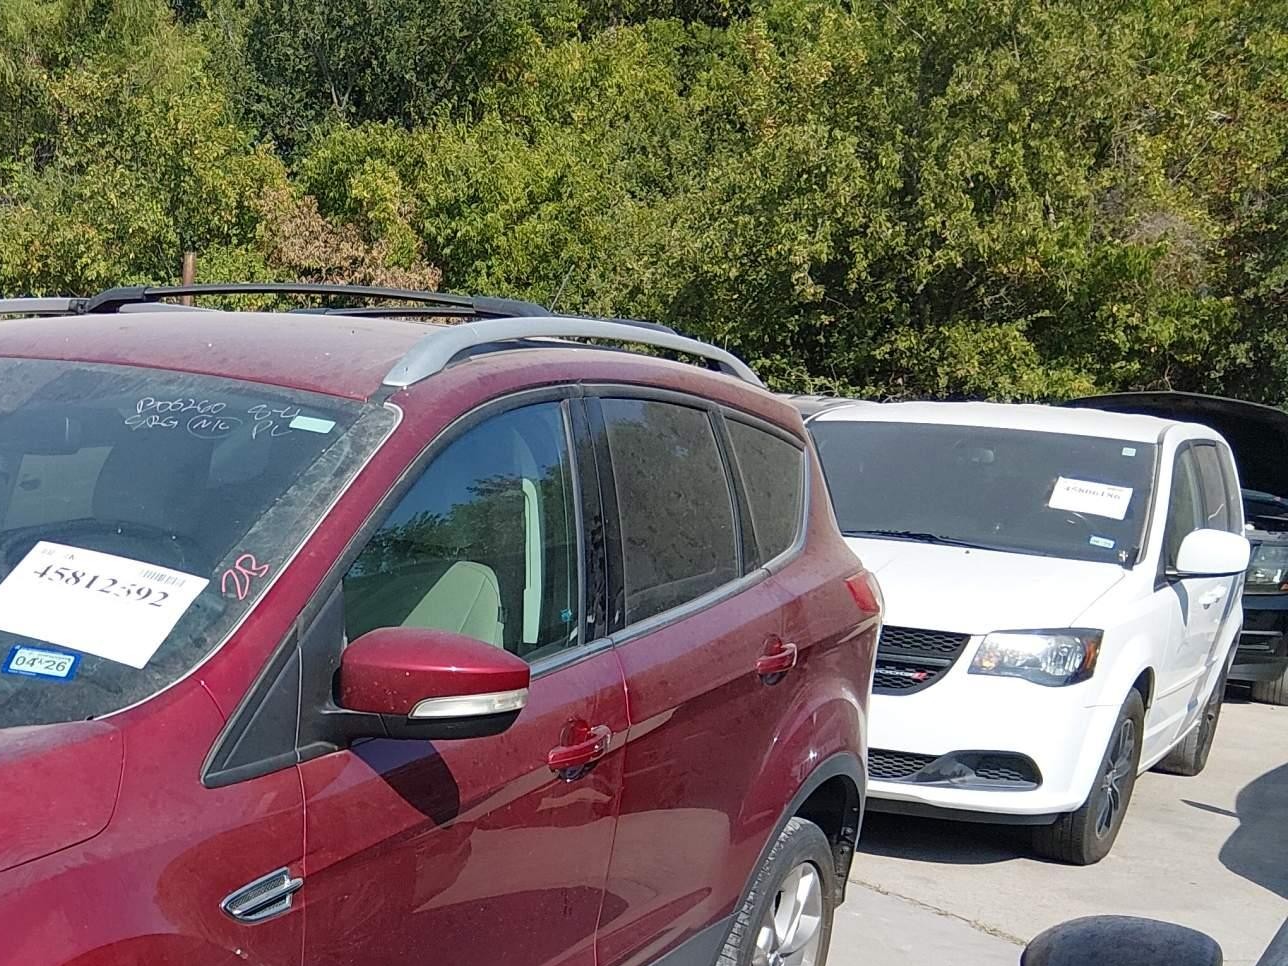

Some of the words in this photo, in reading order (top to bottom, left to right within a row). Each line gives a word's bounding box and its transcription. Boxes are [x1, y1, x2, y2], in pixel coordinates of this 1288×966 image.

[33, 564, 170, 607] 45812592
[15, 655, 38, 667] 04
[44, 660, 67, 672] 26
